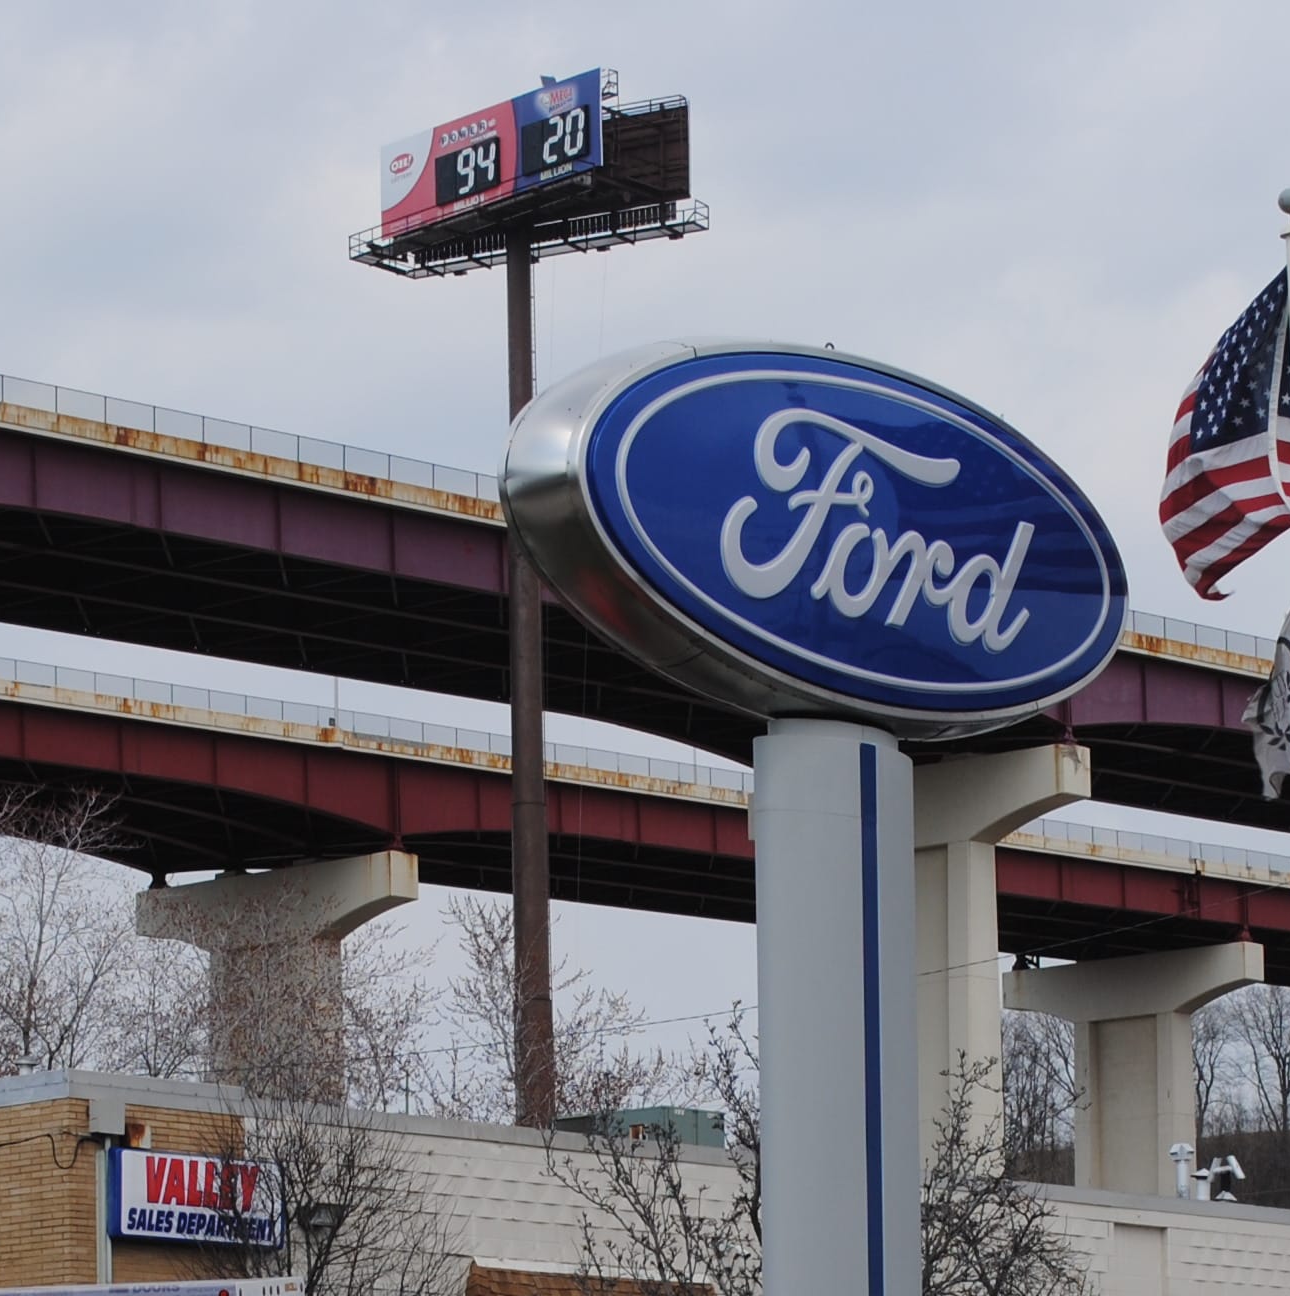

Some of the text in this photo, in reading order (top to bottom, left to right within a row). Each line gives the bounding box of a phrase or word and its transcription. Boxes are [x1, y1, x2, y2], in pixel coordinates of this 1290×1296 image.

[543, 107, 585, 166] 20
[457, 142, 497, 195] 94
[540, 161, 574, 181] MILLION
[720, 407, 1035, 652] Ford
[146, 1155, 259, 1213] VALLEY
[127, 1207, 174, 1234] SALES
